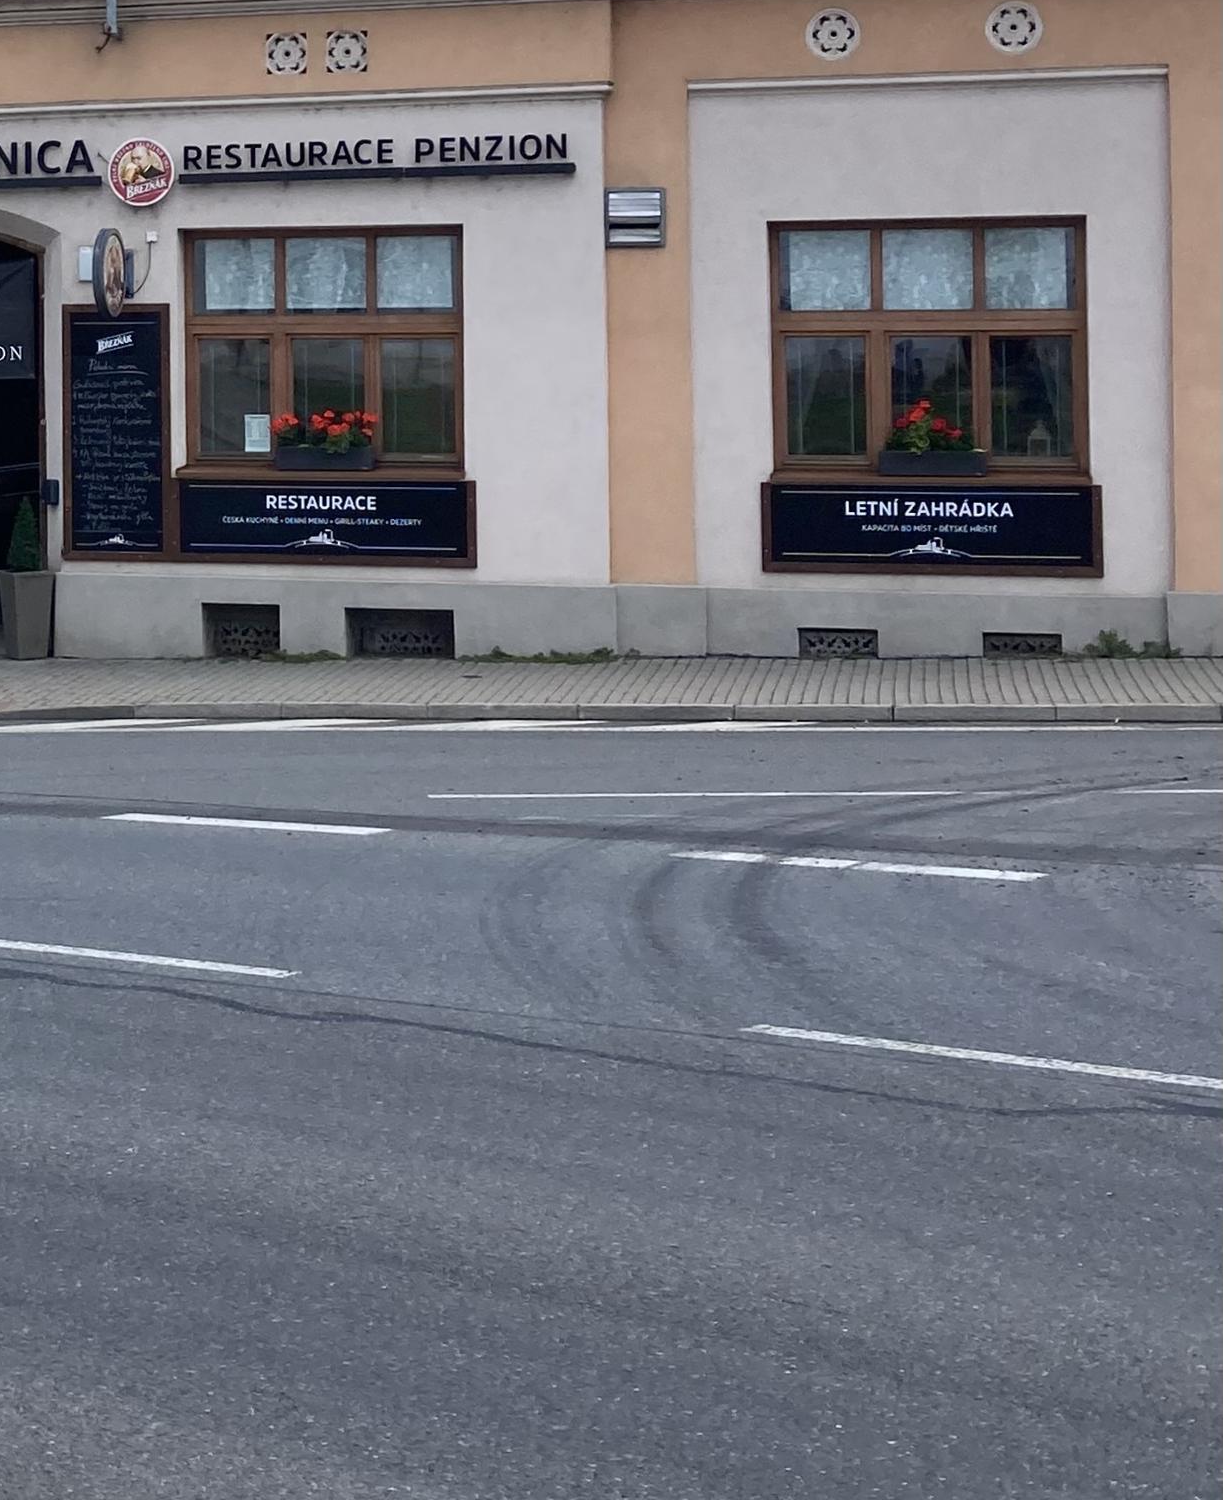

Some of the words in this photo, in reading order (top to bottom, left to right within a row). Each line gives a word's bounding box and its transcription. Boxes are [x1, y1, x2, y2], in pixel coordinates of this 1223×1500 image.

[182, 138, 394, 171] RESTAURACE
[414, 133, 568, 164] PENZION
[266, 494, 377, 511] RESTAURACE
[844, 498, 899, 517] LETNÍ
[904, 498, 1014, 518] ZAHRÁDKA
[308, 517, 328, 525] MENU
[390, 518, 423, 526] DEZERTY
